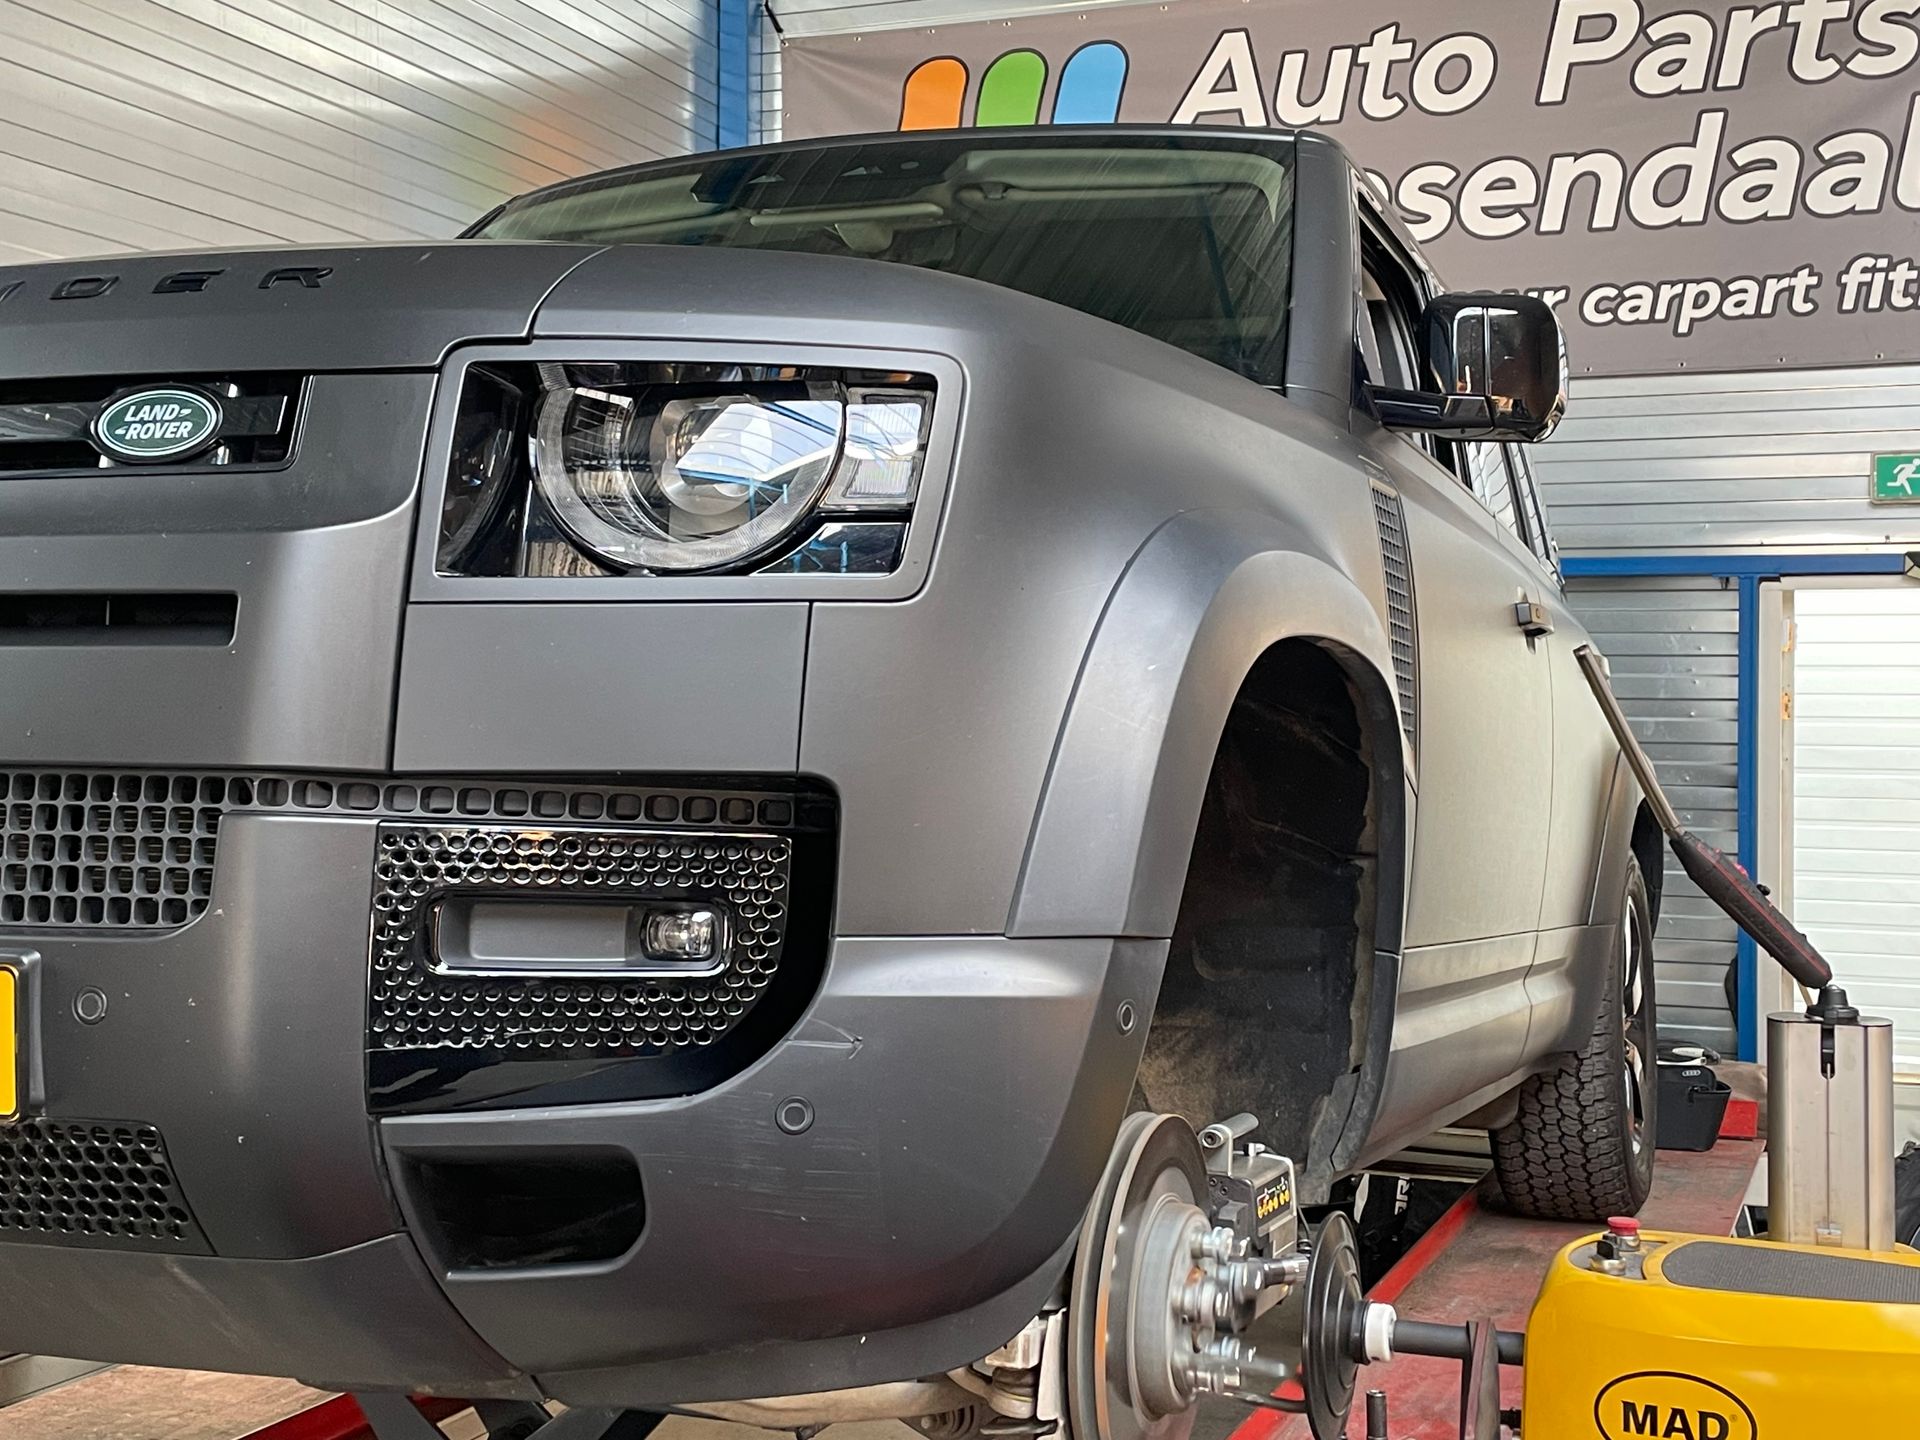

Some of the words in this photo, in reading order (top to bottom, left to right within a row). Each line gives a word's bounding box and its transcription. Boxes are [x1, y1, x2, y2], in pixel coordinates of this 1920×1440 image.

[1171, 24, 1500, 127] Auto
[1535, 0, 1920, 106] Parts
[1361, 91, 1920, 244] sendaal
[1581, 263, 1823, 336] carpart
[1836, 253, 1920, 314] fit
[124, 403, 181, 422] LAND
[124, 421, 194, 440] ROVER
[1621, 1400, 1730, 1440] MAD
